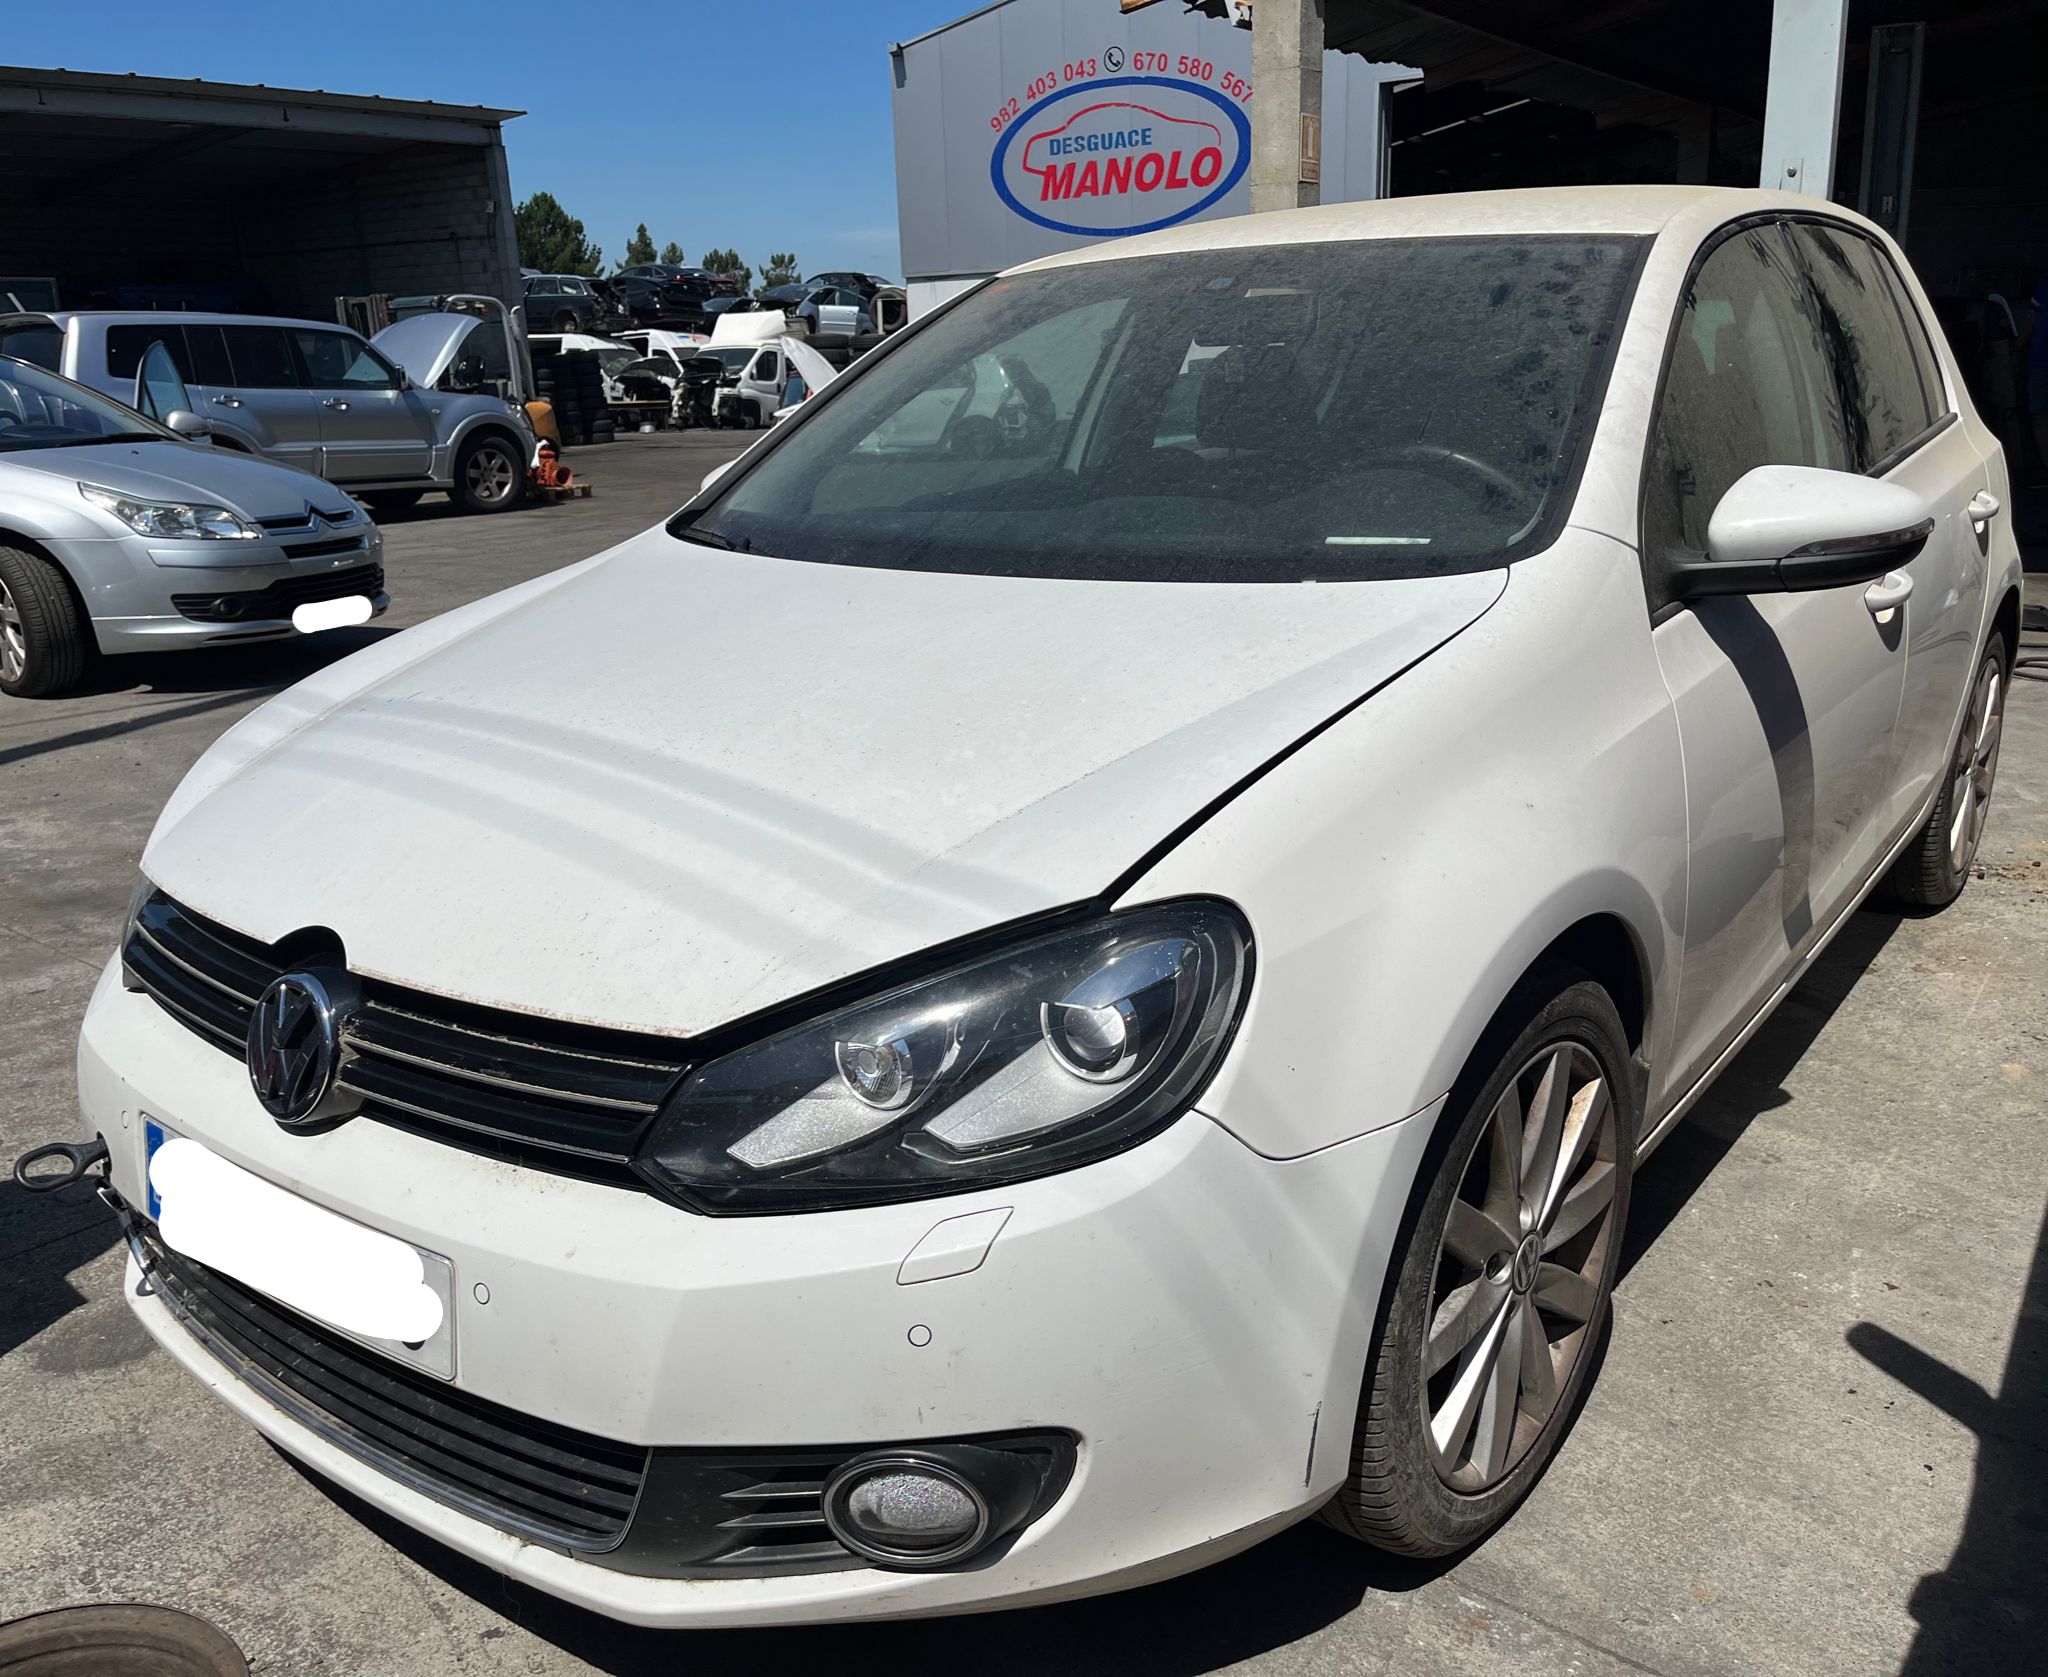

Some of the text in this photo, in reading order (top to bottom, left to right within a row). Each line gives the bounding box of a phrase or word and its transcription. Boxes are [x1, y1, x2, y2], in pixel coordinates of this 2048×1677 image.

[990, 51, 1254, 133] 982 403 043 670 580 567
[1049, 127, 1153, 157] DESGUACE
[1040, 146, 1223, 202] MANOLO
